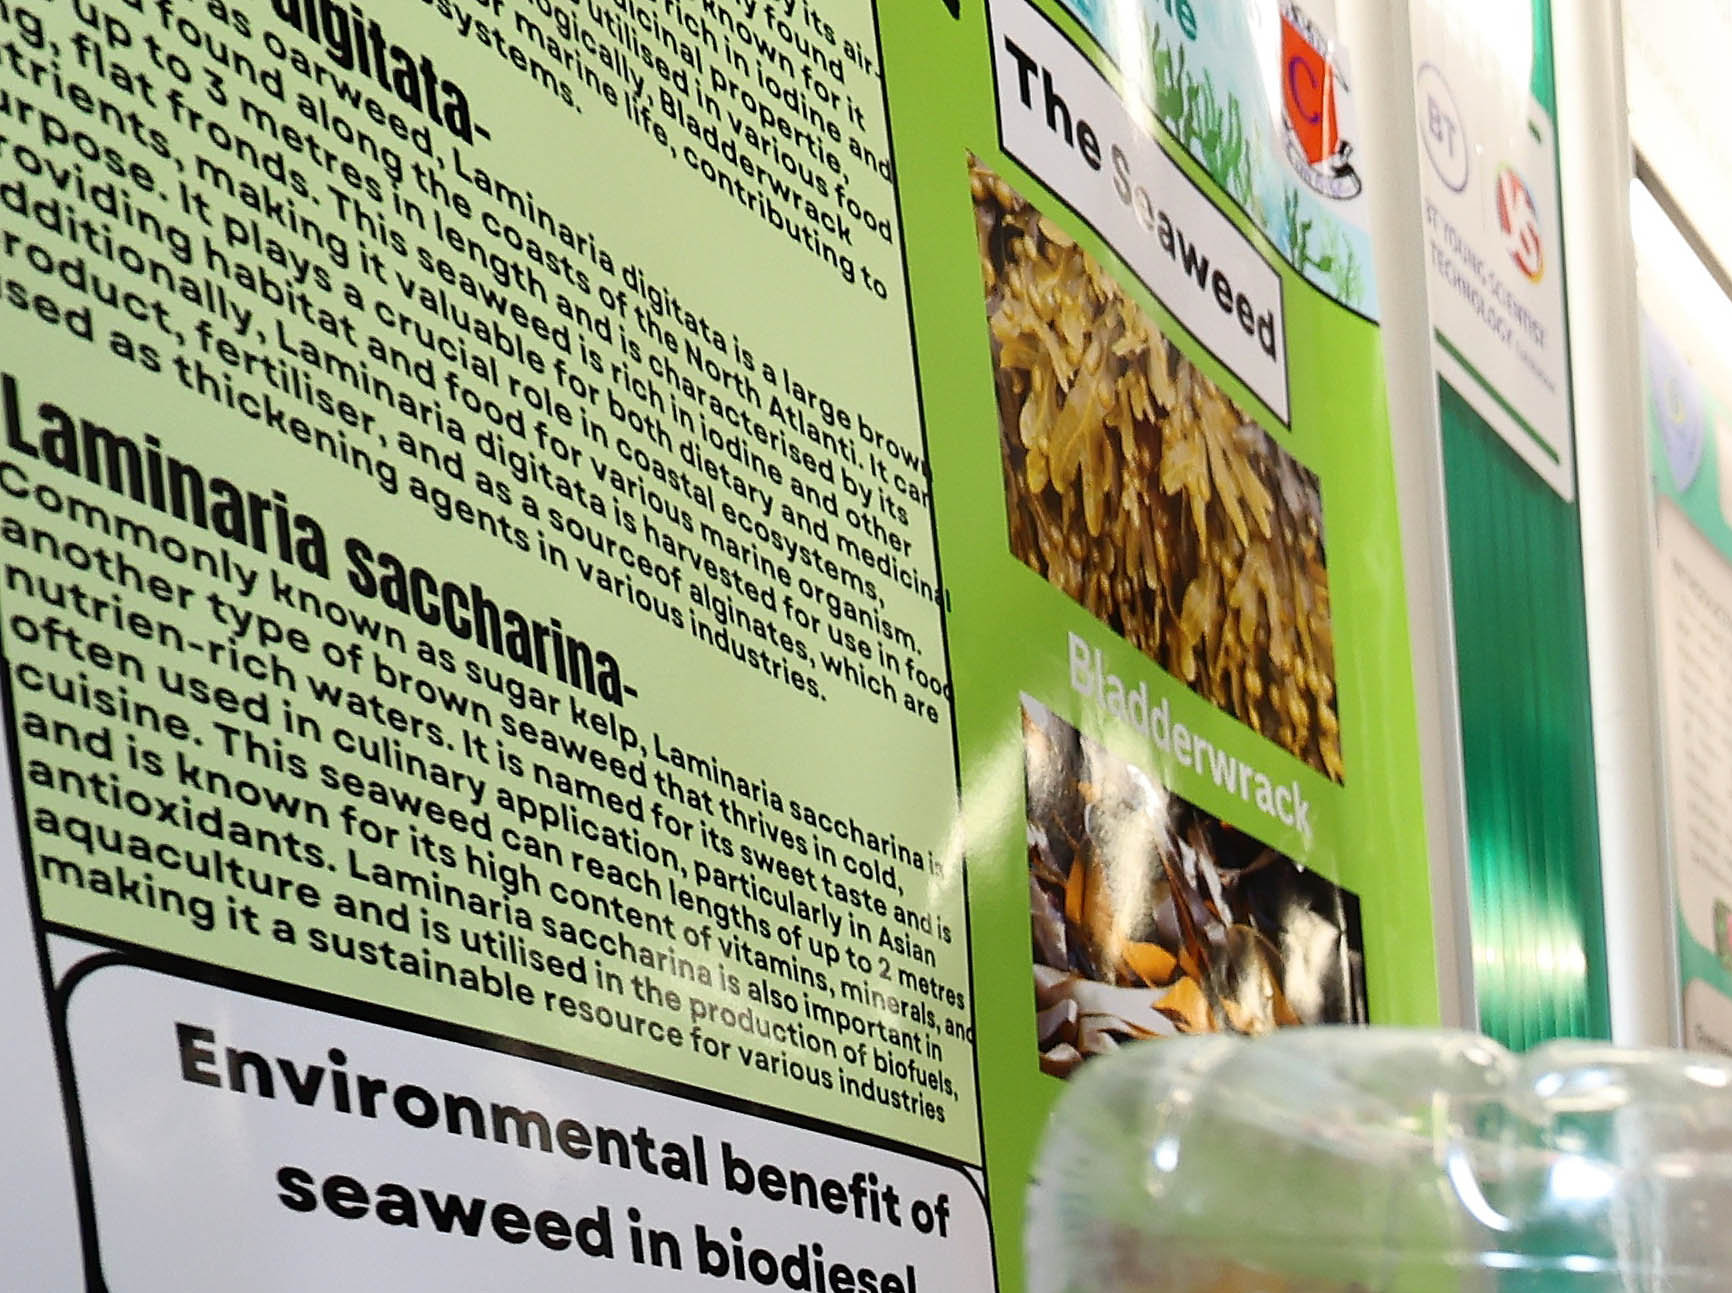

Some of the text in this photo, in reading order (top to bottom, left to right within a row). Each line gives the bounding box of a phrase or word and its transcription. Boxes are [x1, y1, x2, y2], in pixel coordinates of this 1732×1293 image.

[270, 0, 491, 146] igitata-
[514, 10, 887, 299] marine life, contributing to
[1002, 34, 1277, 362] The Seaweed
[0, 373, 640, 709] Laminaria saccharina-
[4, 229, 186, 346] roduct,
[195, 319, 386, 447] fertiliser,
[398, 430, 464, 482] and
[475, 471, 512, 505] as
[521, 494, 539, 520] a
[690, 583, 815, 668] alginates,
[820, 651, 896, 703] which
[904, 693, 938, 723] are
[5, 278, 825, 701] sed as thickening agents in various industries.
[12, 614, 935, 967] often used in culinary application, particularly in Asian
[1068, 631, 1315, 842] Bladderwrack
[40, 854, 945, 1123] making it a sustainable resource for various industries
[176, 1022, 950, 1239] Environmental benefit of
[277, 1164, 612, 1258] seaweed
[629, 1209, 681, 1270] in
